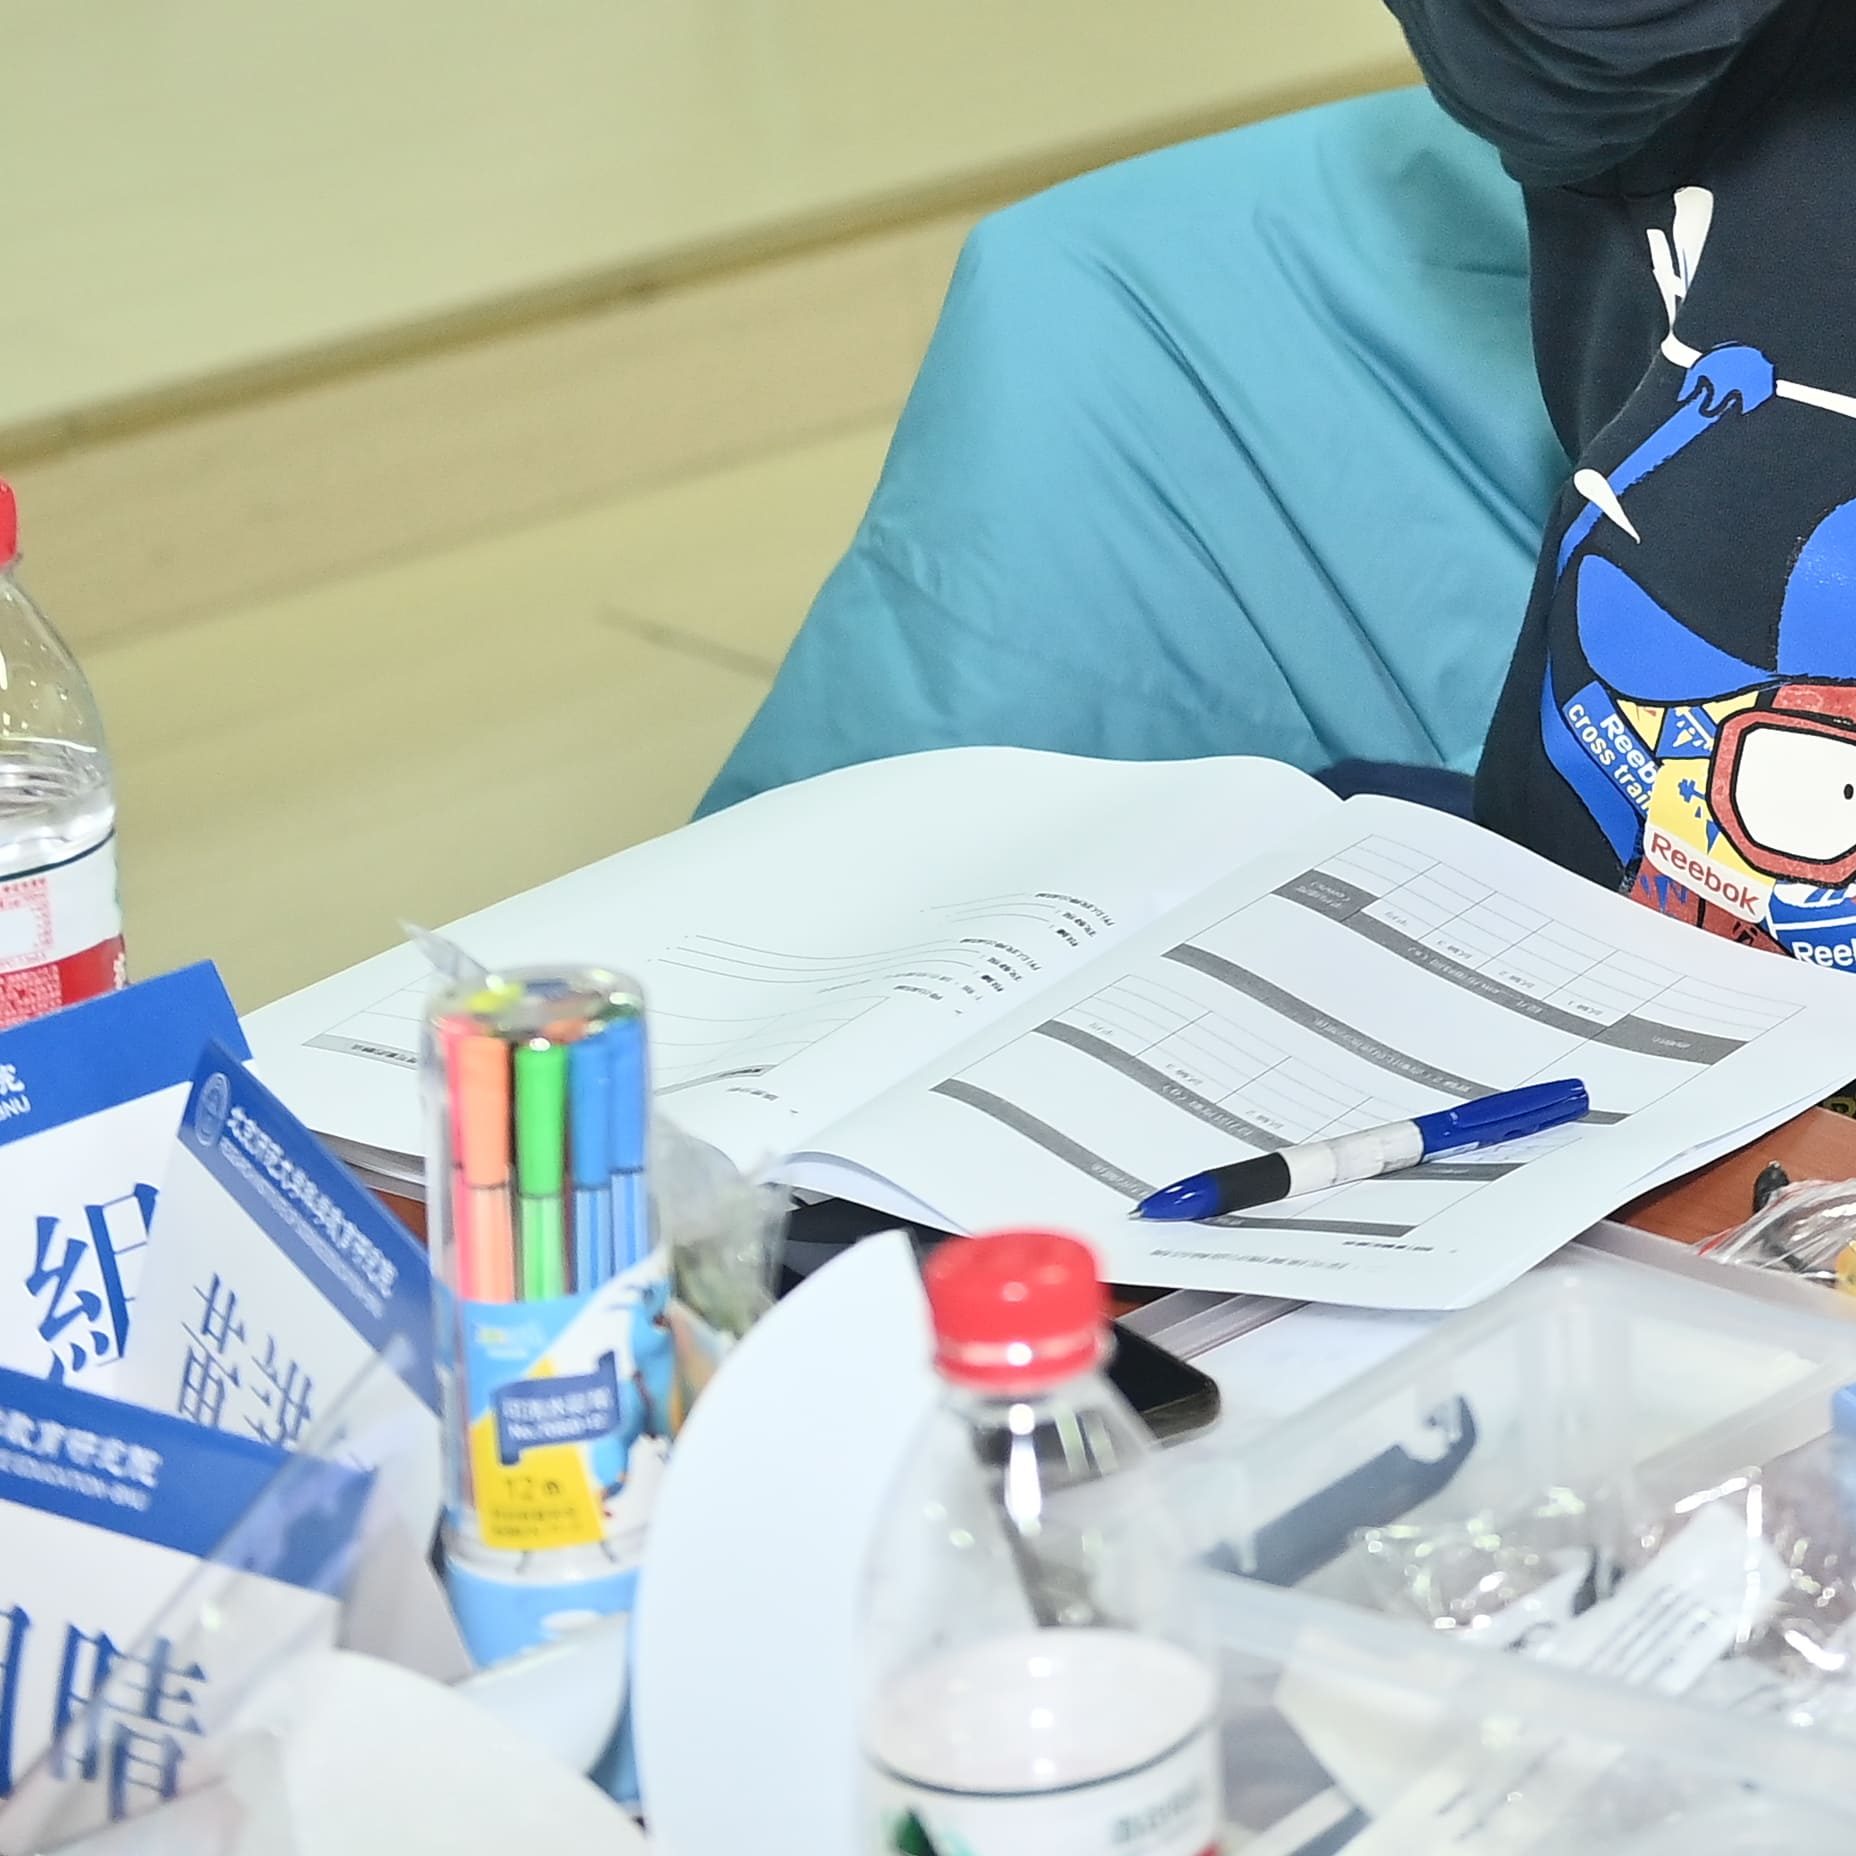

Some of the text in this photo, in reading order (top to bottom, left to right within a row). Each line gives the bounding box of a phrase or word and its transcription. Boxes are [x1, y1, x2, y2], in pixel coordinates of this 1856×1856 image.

[1568, 703, 1652, 811] cross trai
[1650, 831, 1760, 917] Reebok
